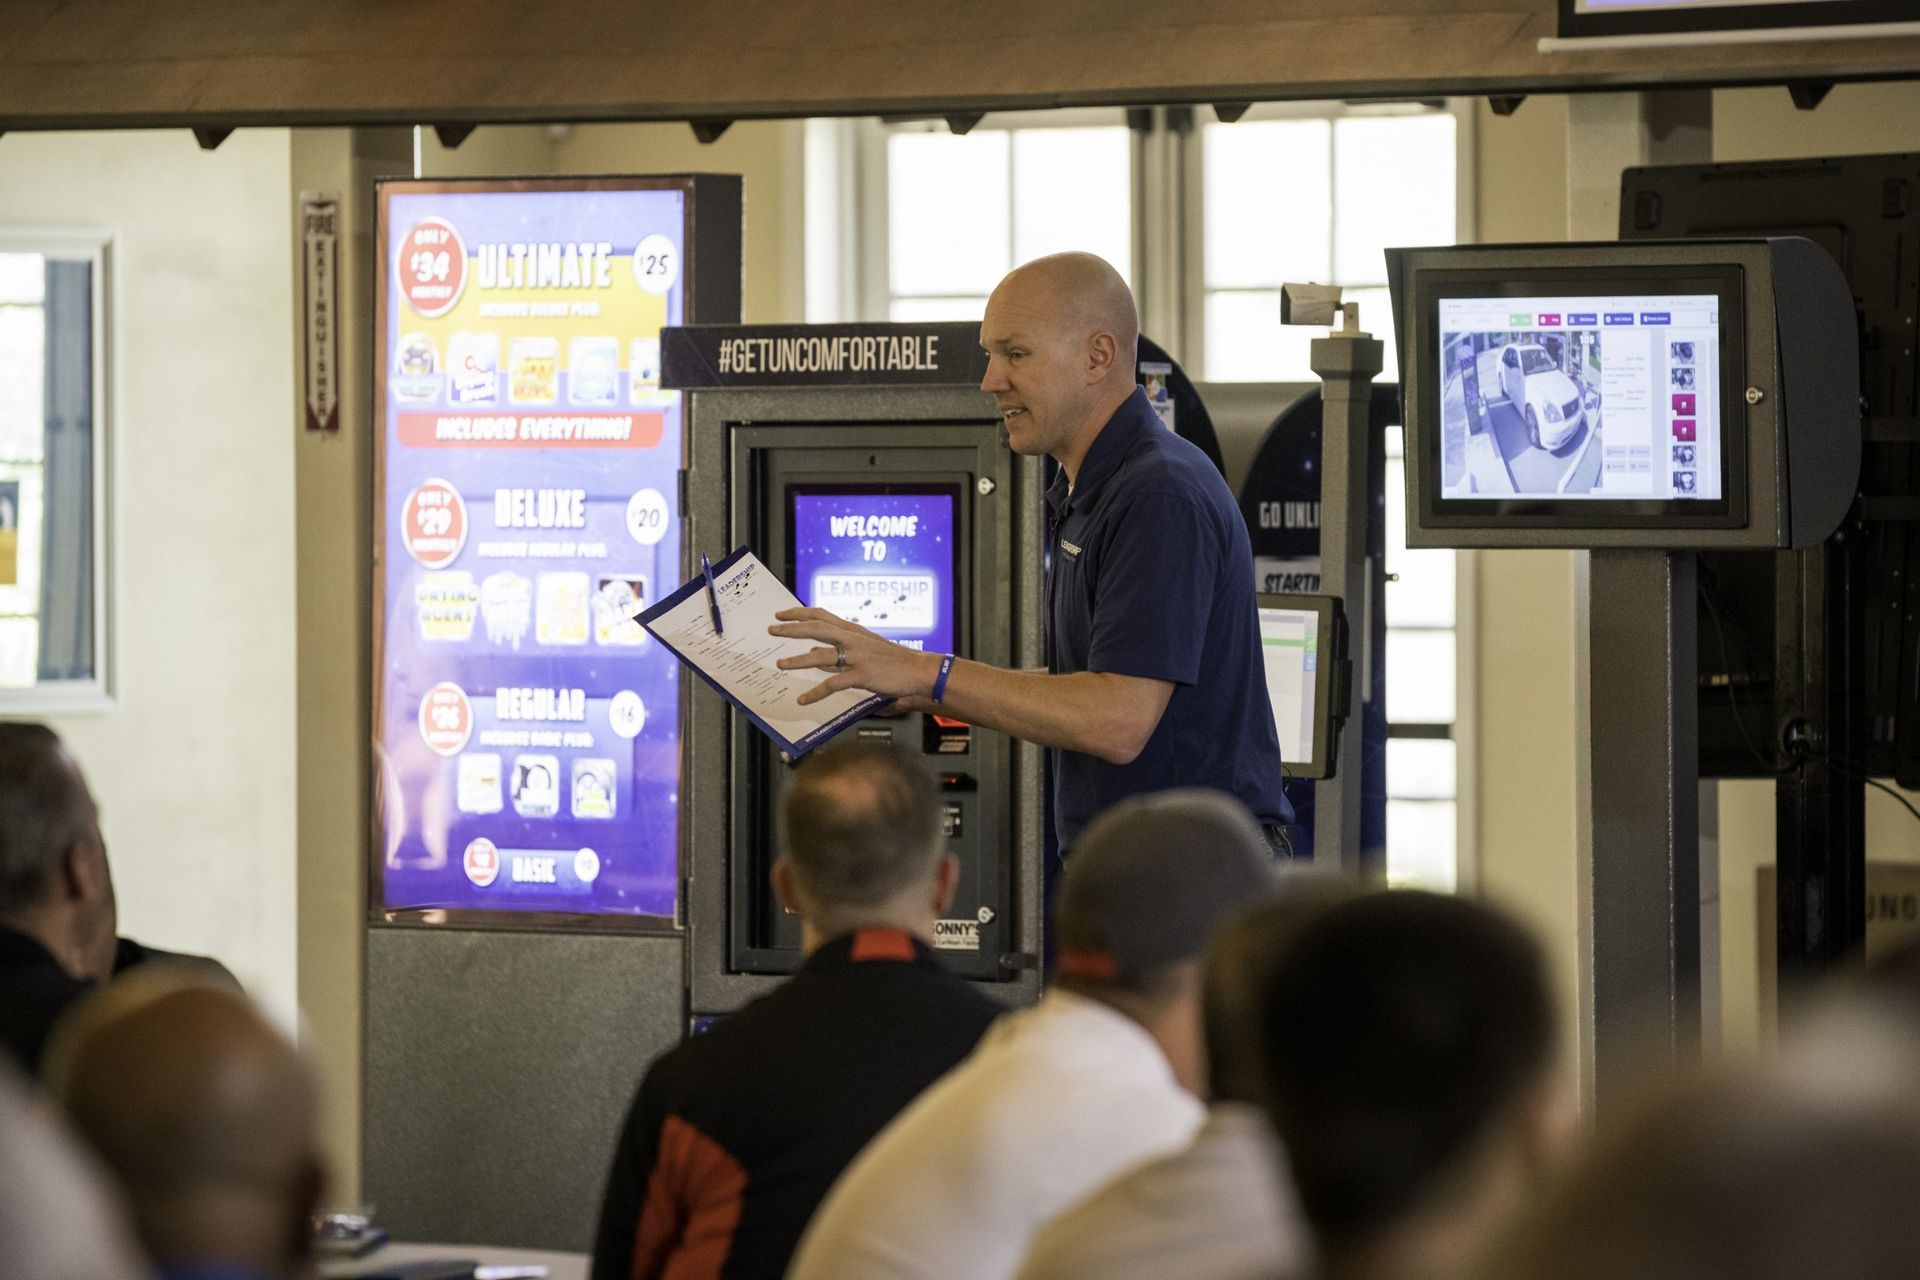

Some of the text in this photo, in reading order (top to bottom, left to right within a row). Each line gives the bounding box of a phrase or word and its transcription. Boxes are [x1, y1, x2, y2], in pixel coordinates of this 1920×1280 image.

[414, 229, 449, 245] ONLY
[477, 242, 612, 288] ULTIMATE
[718, 336, 939, 373] #GETUNCOMFORTABLE
[436, 416, 633, 440] INCLUDES EVERYTHING!
[495, 488, 586, 528] DELUXE
[1260, 502, 1280, 528] GO
[830, 515, 918, 537] WELCOME
[862, 540, 887, 561] TO
[717, 563, 755, 594] LEADERSHIP
[820, 581, 928, 597] LEADERSHIP
[496, 687, 585, 721] REGULAR
[512, 857, 556, 882] BASIC
